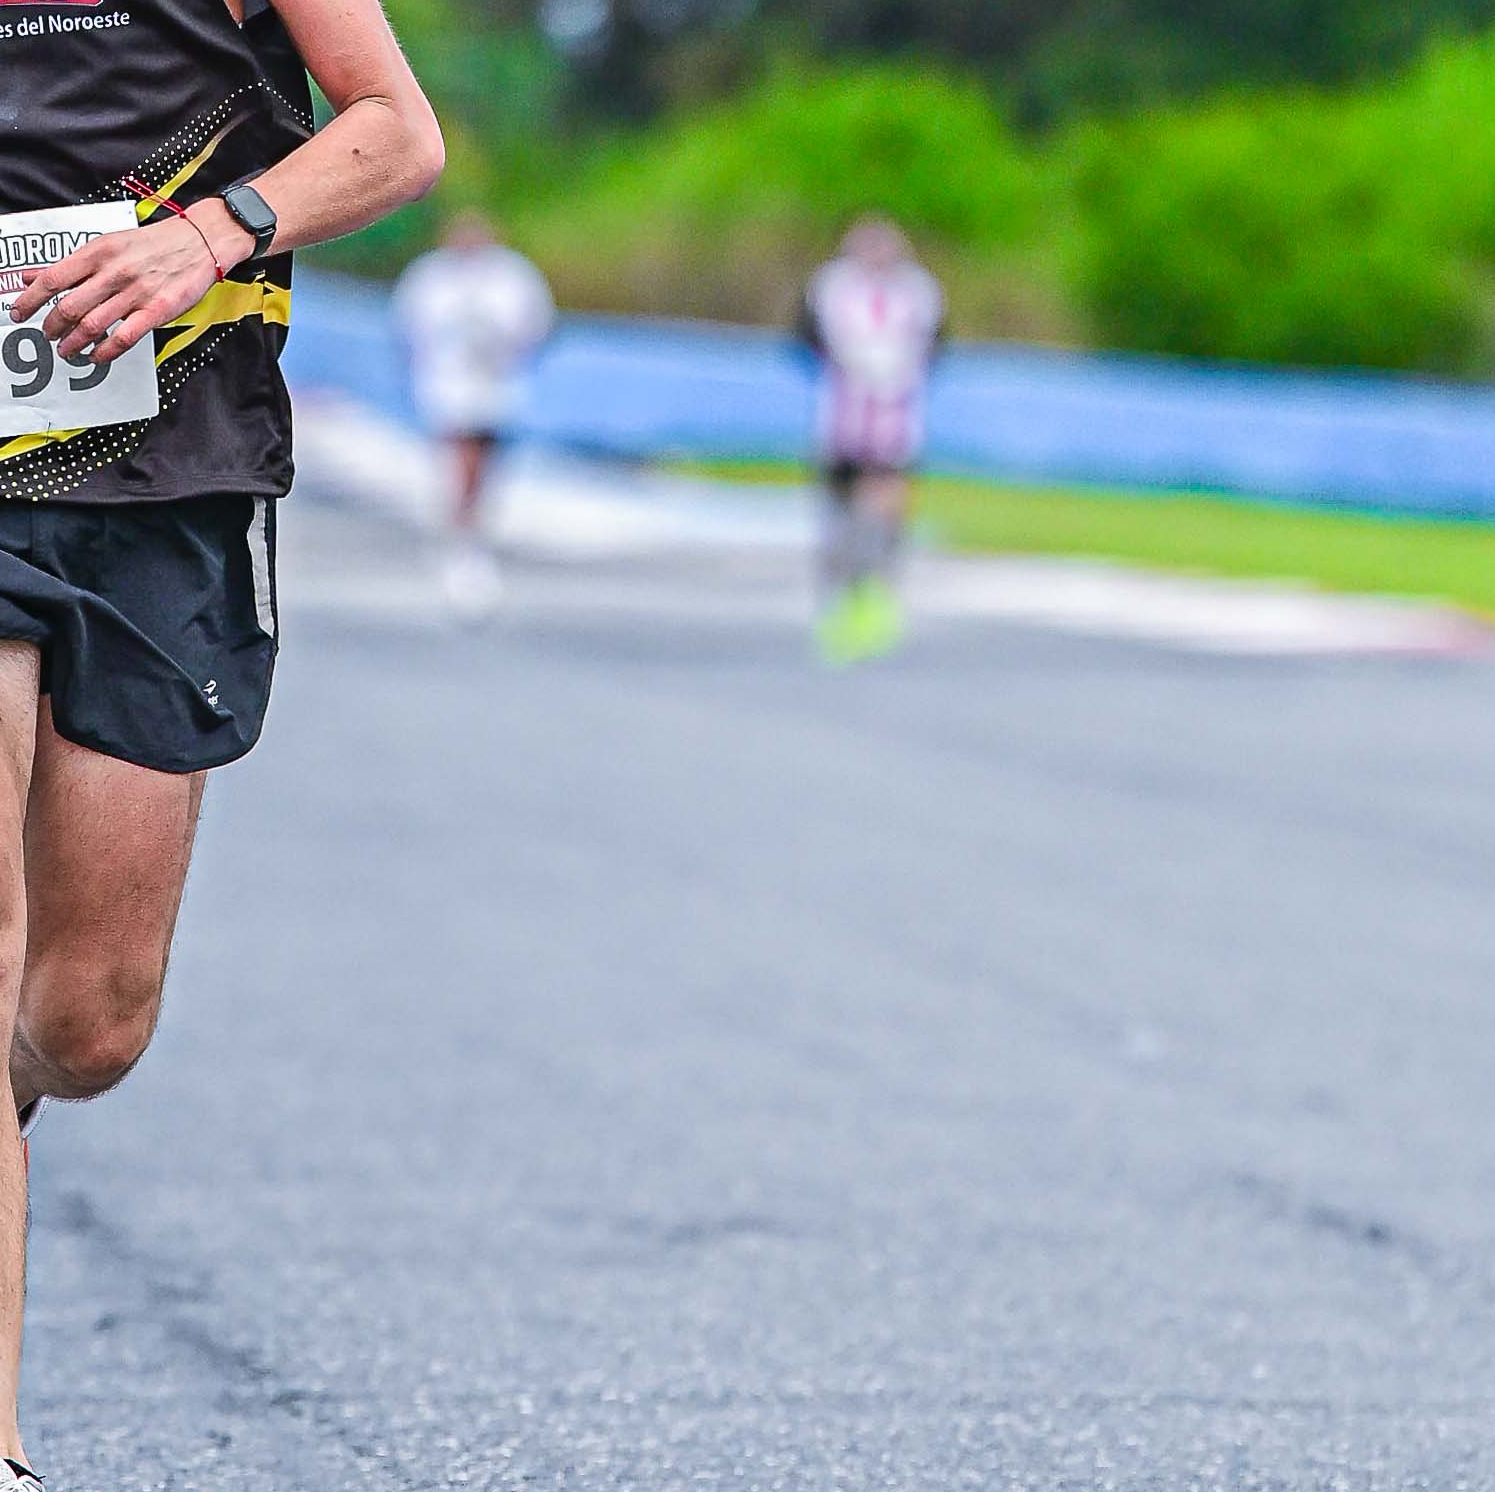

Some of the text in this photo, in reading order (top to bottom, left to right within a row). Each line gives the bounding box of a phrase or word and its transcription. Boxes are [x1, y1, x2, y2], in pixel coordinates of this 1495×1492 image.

[17, 15, 45, 37] del
[48, 10, 131, 33] Noroeste
[2, 301, 15, 312] lo
